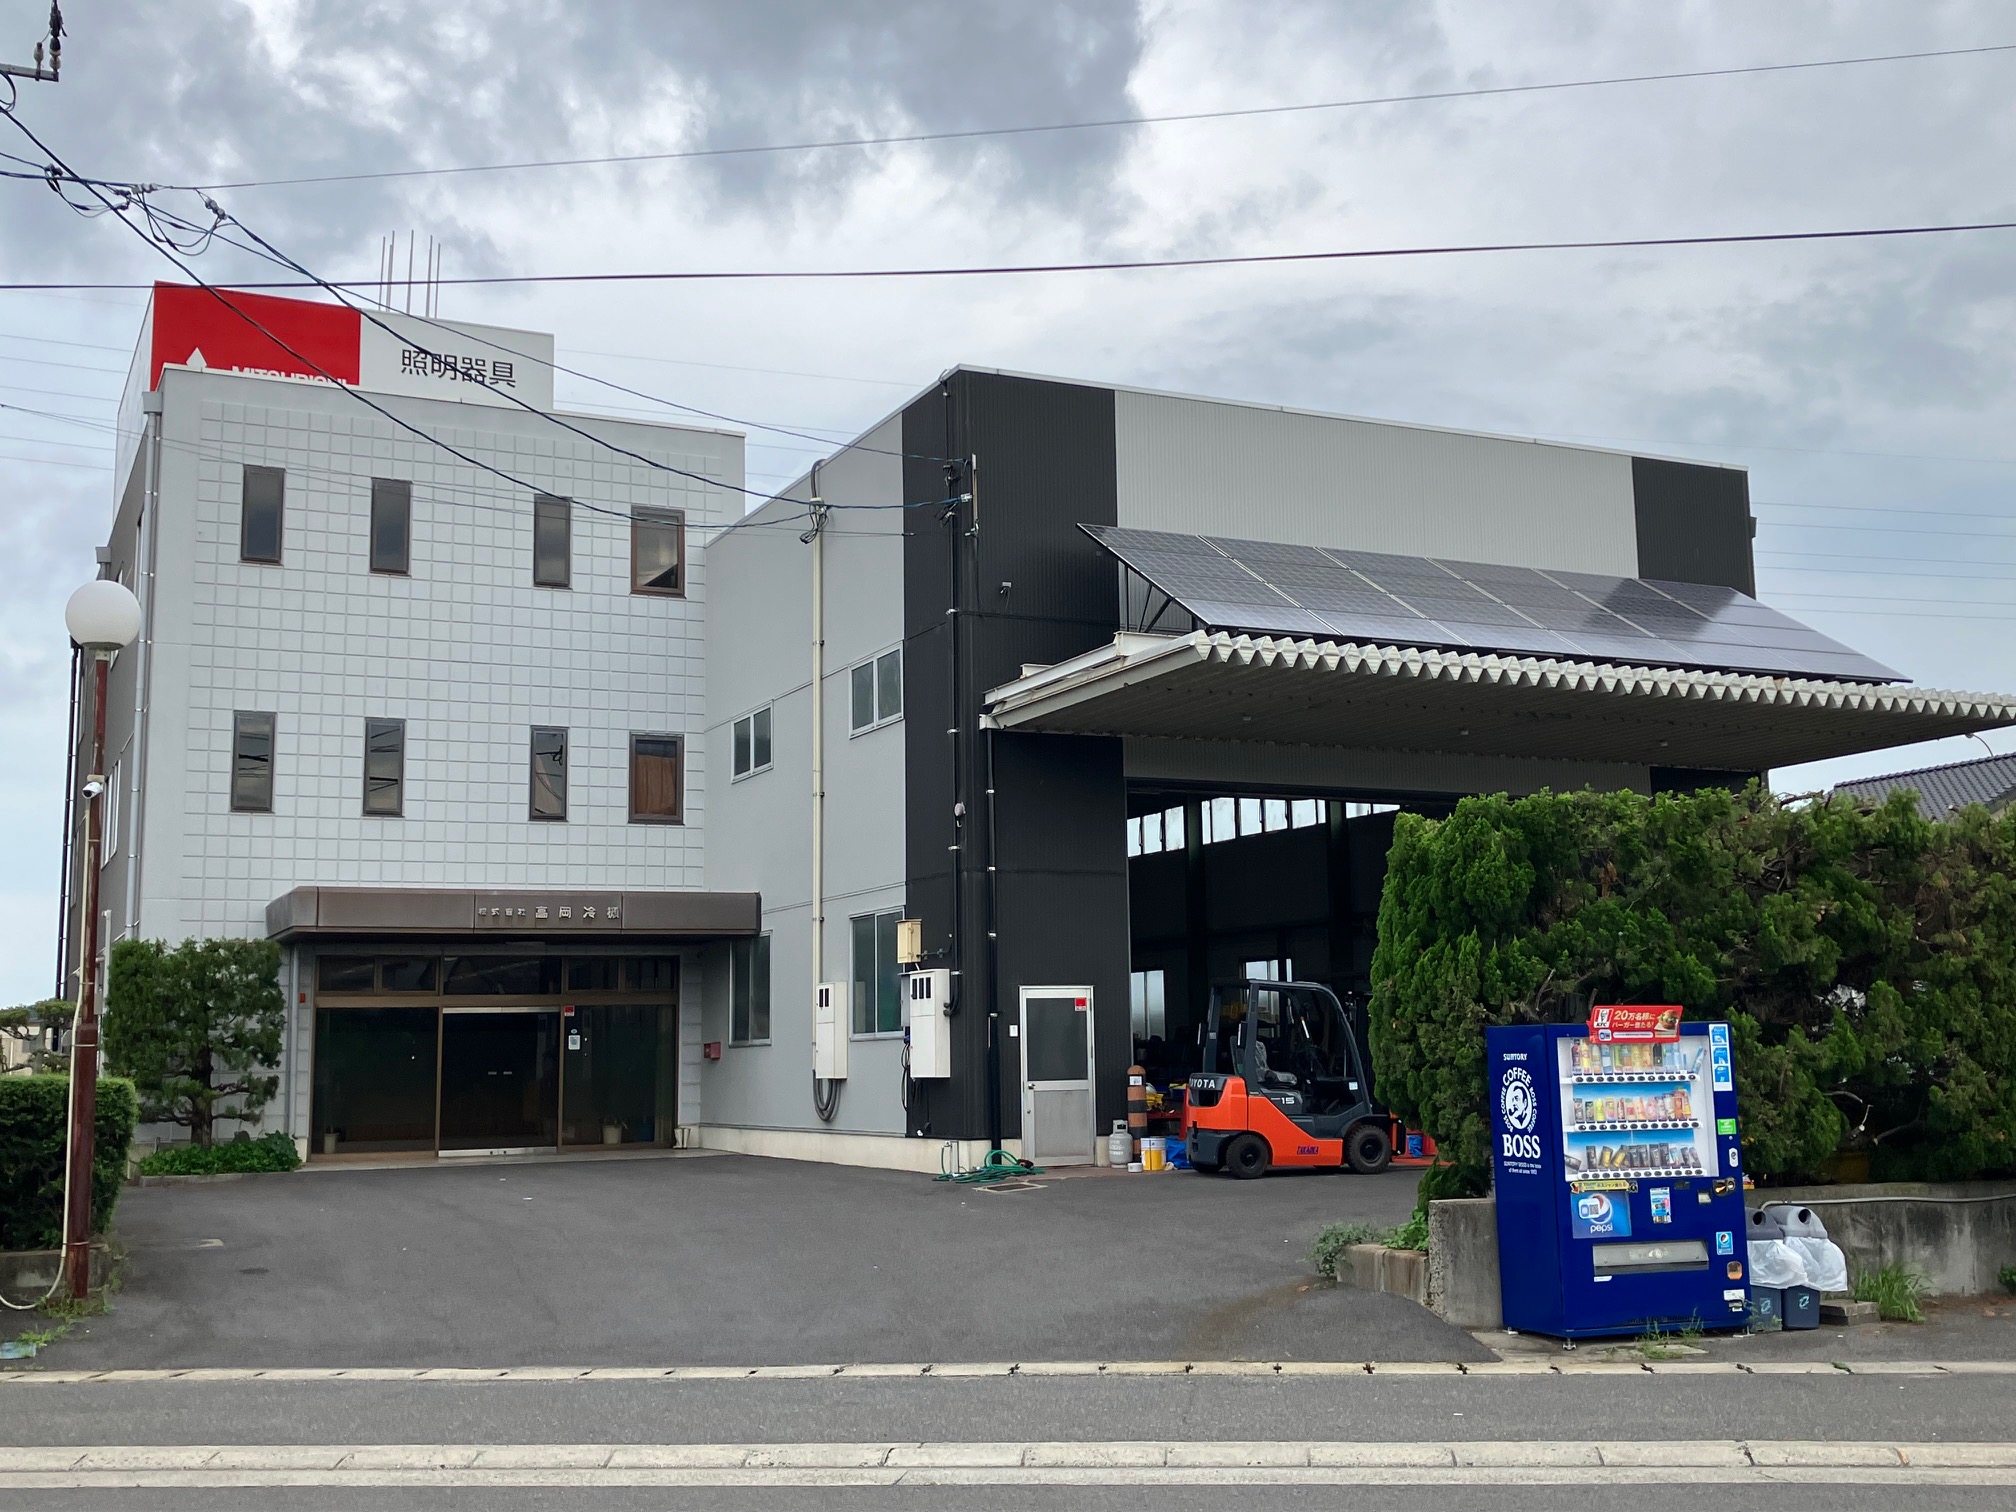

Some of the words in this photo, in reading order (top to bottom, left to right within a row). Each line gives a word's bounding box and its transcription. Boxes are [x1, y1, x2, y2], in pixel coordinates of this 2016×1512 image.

[401, 349, 516, 388] 照明器具
[1502, 1067, 1532, 1087] COFFEE
[1281, 1096, 1295, 1105] 15
[1502, 1134, 1541, 1159] BOSS
[1590, 1223, 1613, 1233] pepsi
